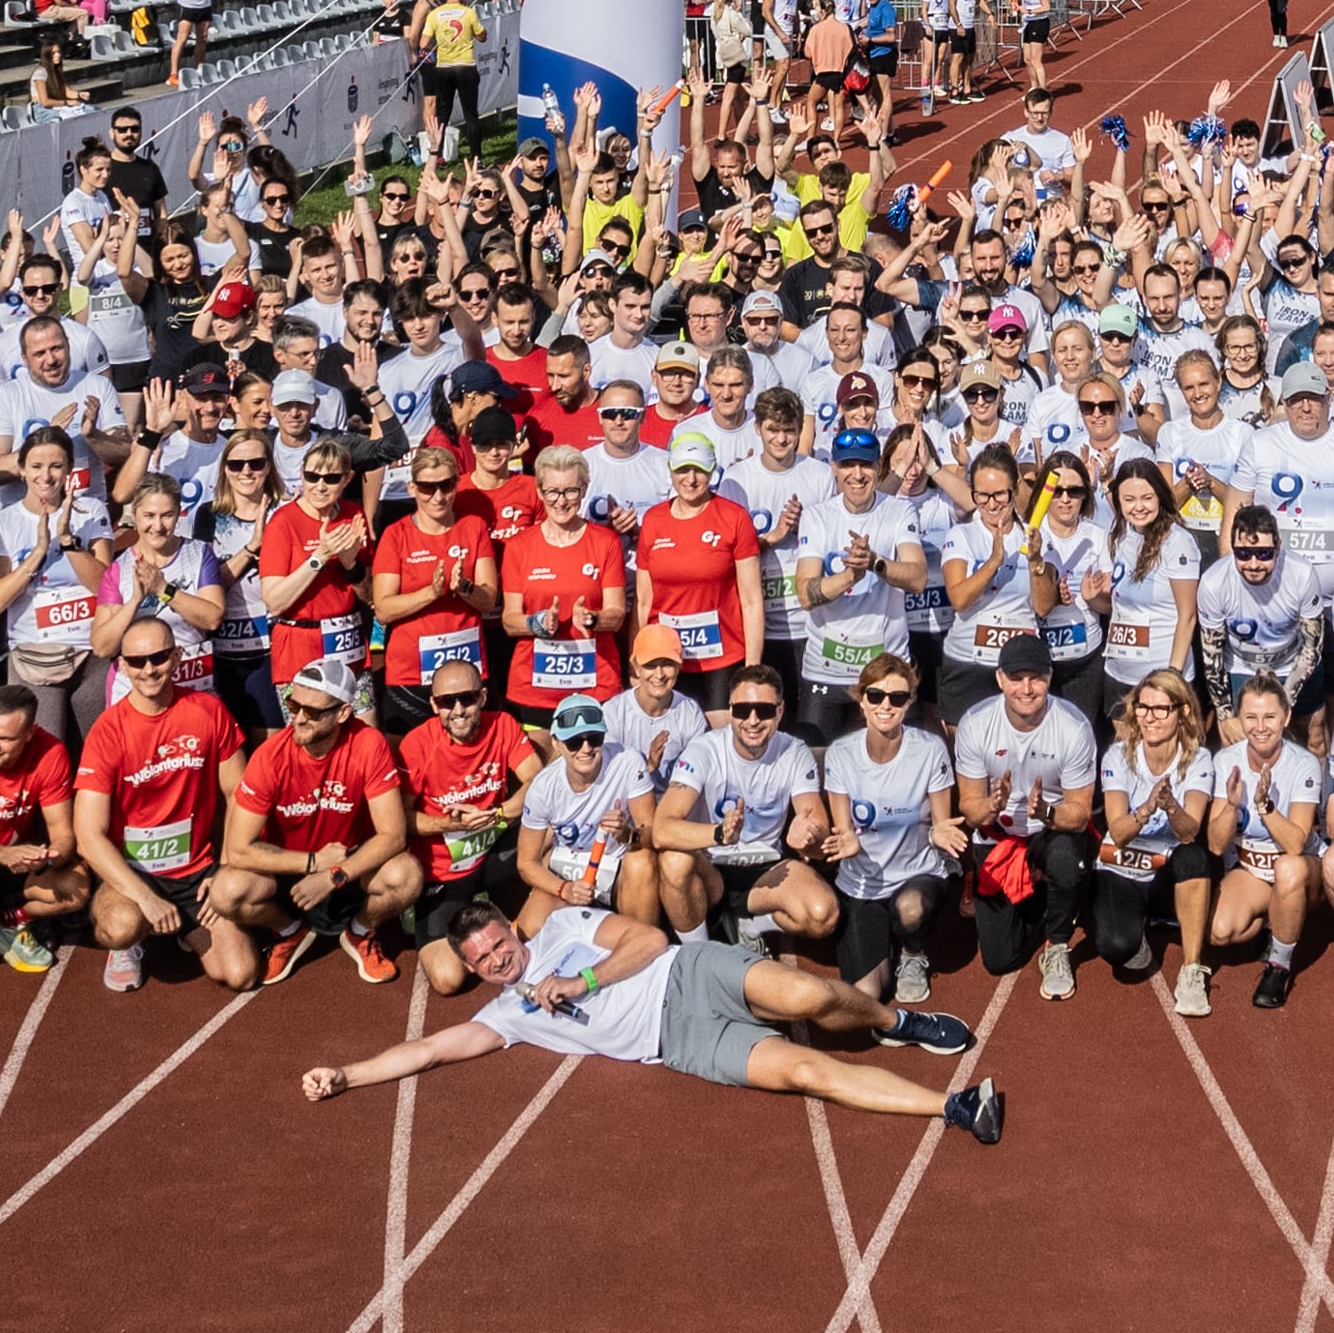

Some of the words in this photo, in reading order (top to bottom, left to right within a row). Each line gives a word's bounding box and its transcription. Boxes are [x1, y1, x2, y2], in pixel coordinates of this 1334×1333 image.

[101, 298, 122, 309] 8/4
[1279, 306, 1308, 318] IRON
[1003, 402, 1026, 410] RON
[1289, 532, 1326, 549] 57/4
[906, 590, 941, 610] 53/3
[49, 604, 90, 624] 66/3
[335, 634, 360, 652] 25/5
[680, 629, 708, 647] 5/4
[1047, 628, 1073, 645] 3/2
[1111, 629, 1137, 645] 26/3
[434, 647, 470, 666] 25/2
[834, 644, 872, 664] 55/4
[171, 659, 204, 682] 31/3
[545, 655, 584, 674] 25/3
[124, 755, 205, 787] Wolontariusz
[136, 839, 179, 859] 41/2
[461, 833, 497, 856] 41/4
[1114, 849, 1153, 869] 12/5
